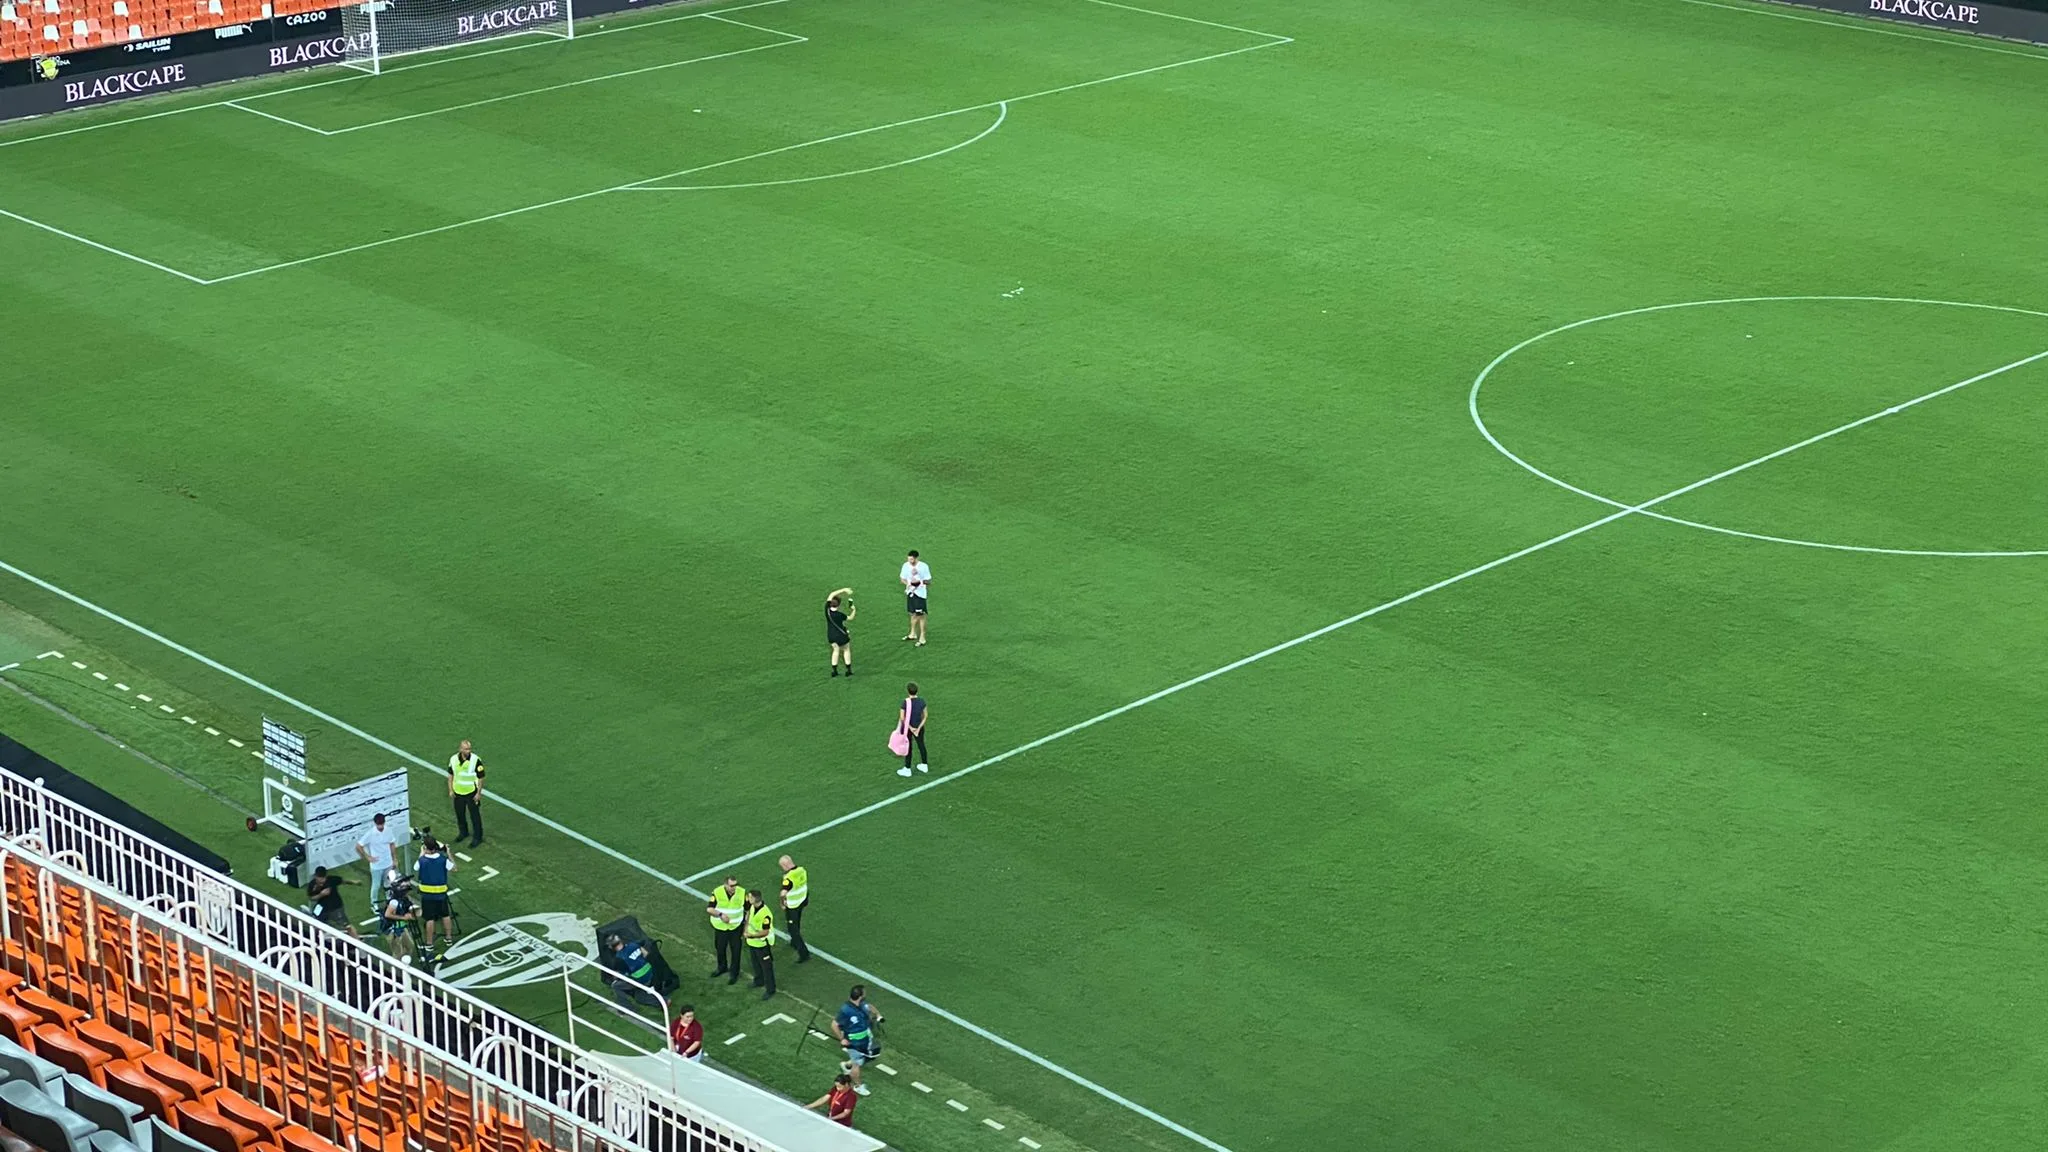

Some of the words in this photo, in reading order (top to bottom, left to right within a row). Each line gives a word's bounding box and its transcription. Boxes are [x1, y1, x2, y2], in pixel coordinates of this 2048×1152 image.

[286, 10, 327, 26] CAZOO
[457, 0, 559, 35] BLACKCAPE
[135, 37, 171, 51] SAILUN
[64, 64, 186, 102] BLACKCAPE
[501, 924, 554, 954] VALENCIA
